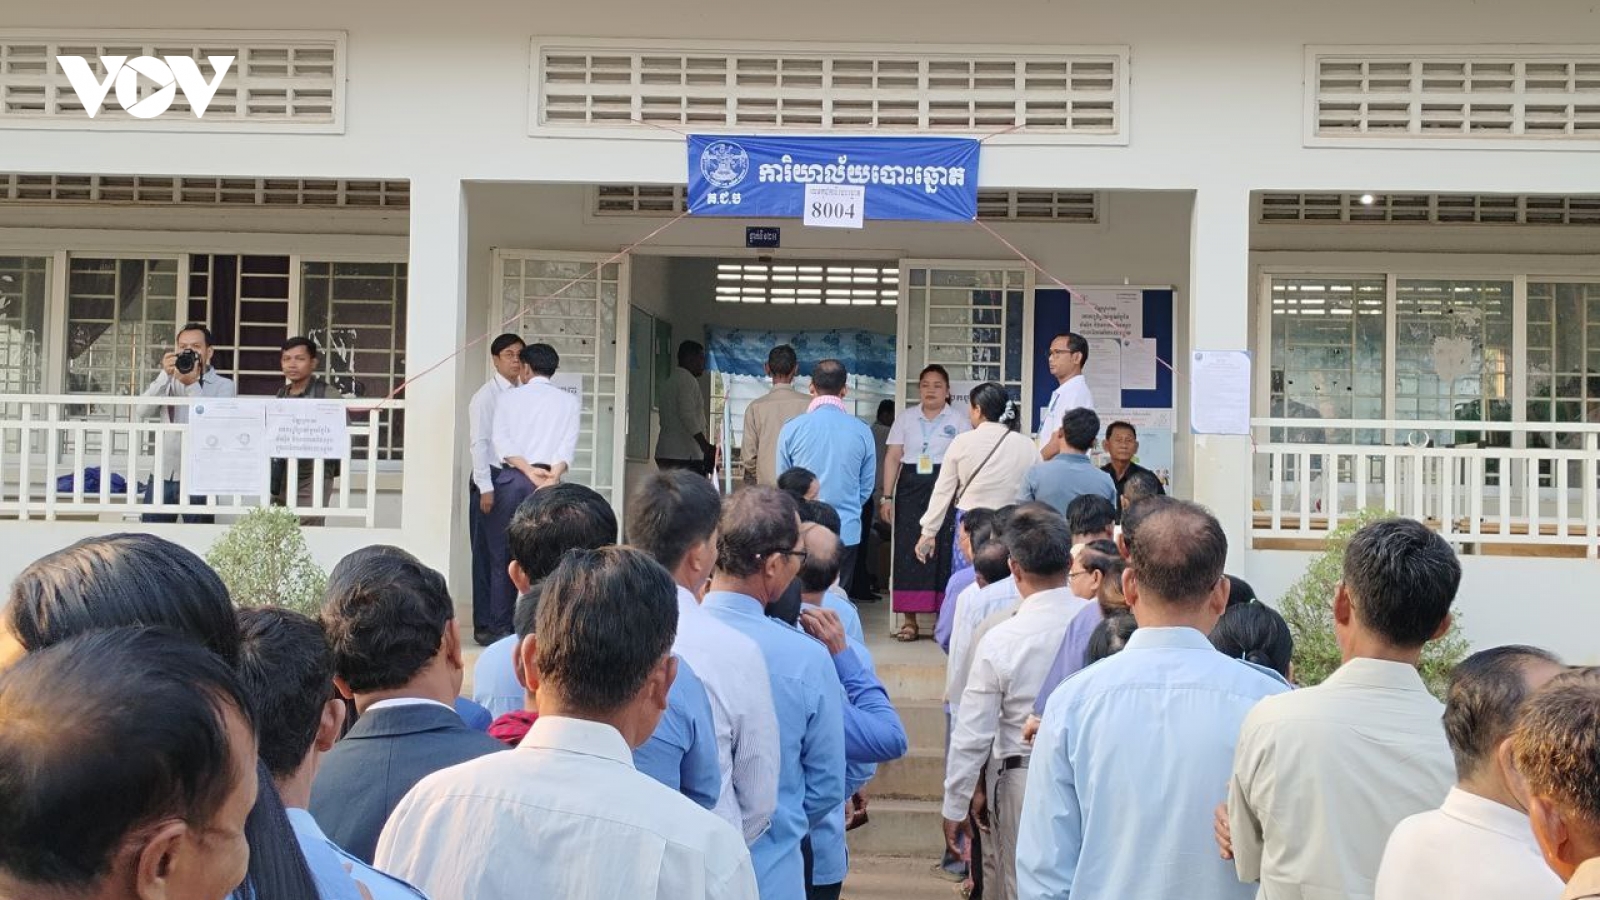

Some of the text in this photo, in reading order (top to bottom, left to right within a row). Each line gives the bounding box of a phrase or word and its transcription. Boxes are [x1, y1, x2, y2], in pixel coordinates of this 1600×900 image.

[759, 154, 966, 195] ការិយាល័យបោះឆ្នោត
[811, 202, 856, 219] 8004
